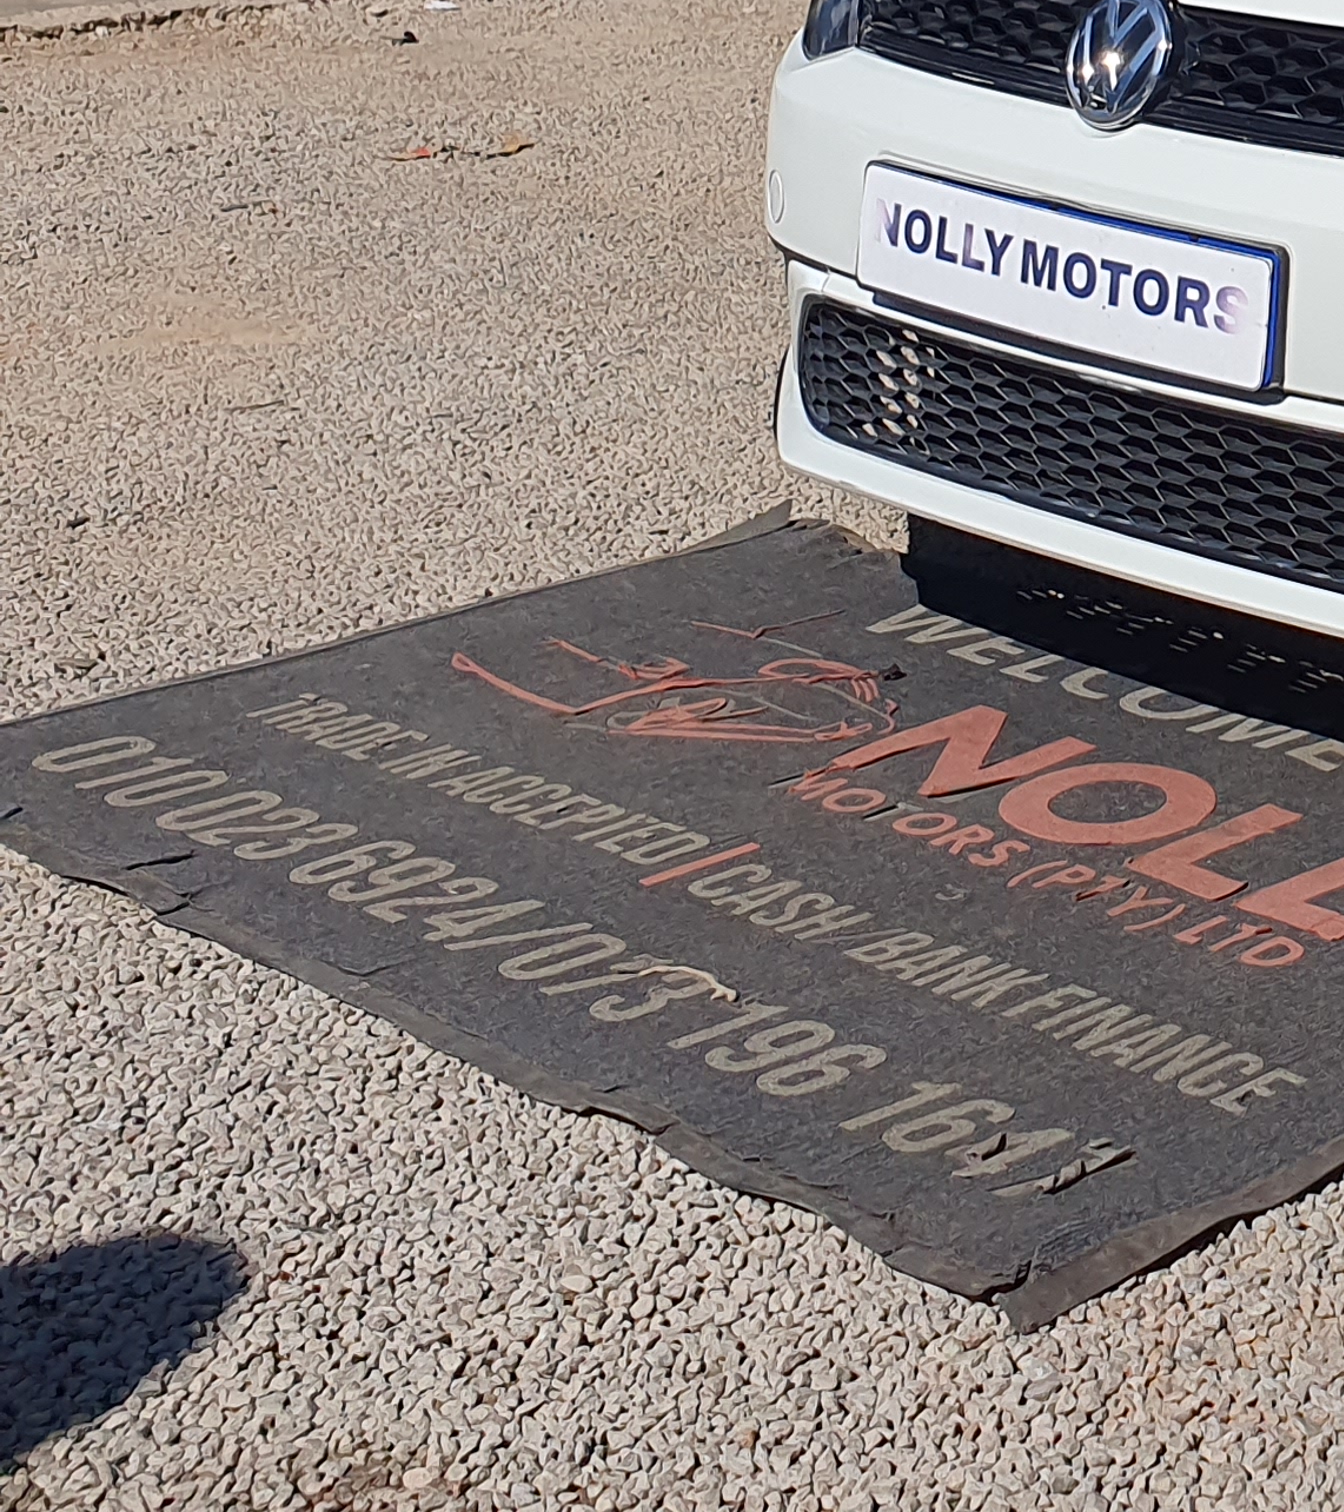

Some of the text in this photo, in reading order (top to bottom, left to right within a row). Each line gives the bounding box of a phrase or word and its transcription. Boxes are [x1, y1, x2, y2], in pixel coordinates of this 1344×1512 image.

[874, 198, 1249, 335] NOLLY MOTORS
[245, 693, 431, 762] TRADE
[377, 744, 483, 780] IN
[427, 765, 712, 866] ACCEPTED
[787, 772, 1031, 868] MOTORS
[1173, 915, 1305, 967] LTD
[666, 1000, 889, 1097] 196
[1000, 983, 1309, 1117] FINANCE
